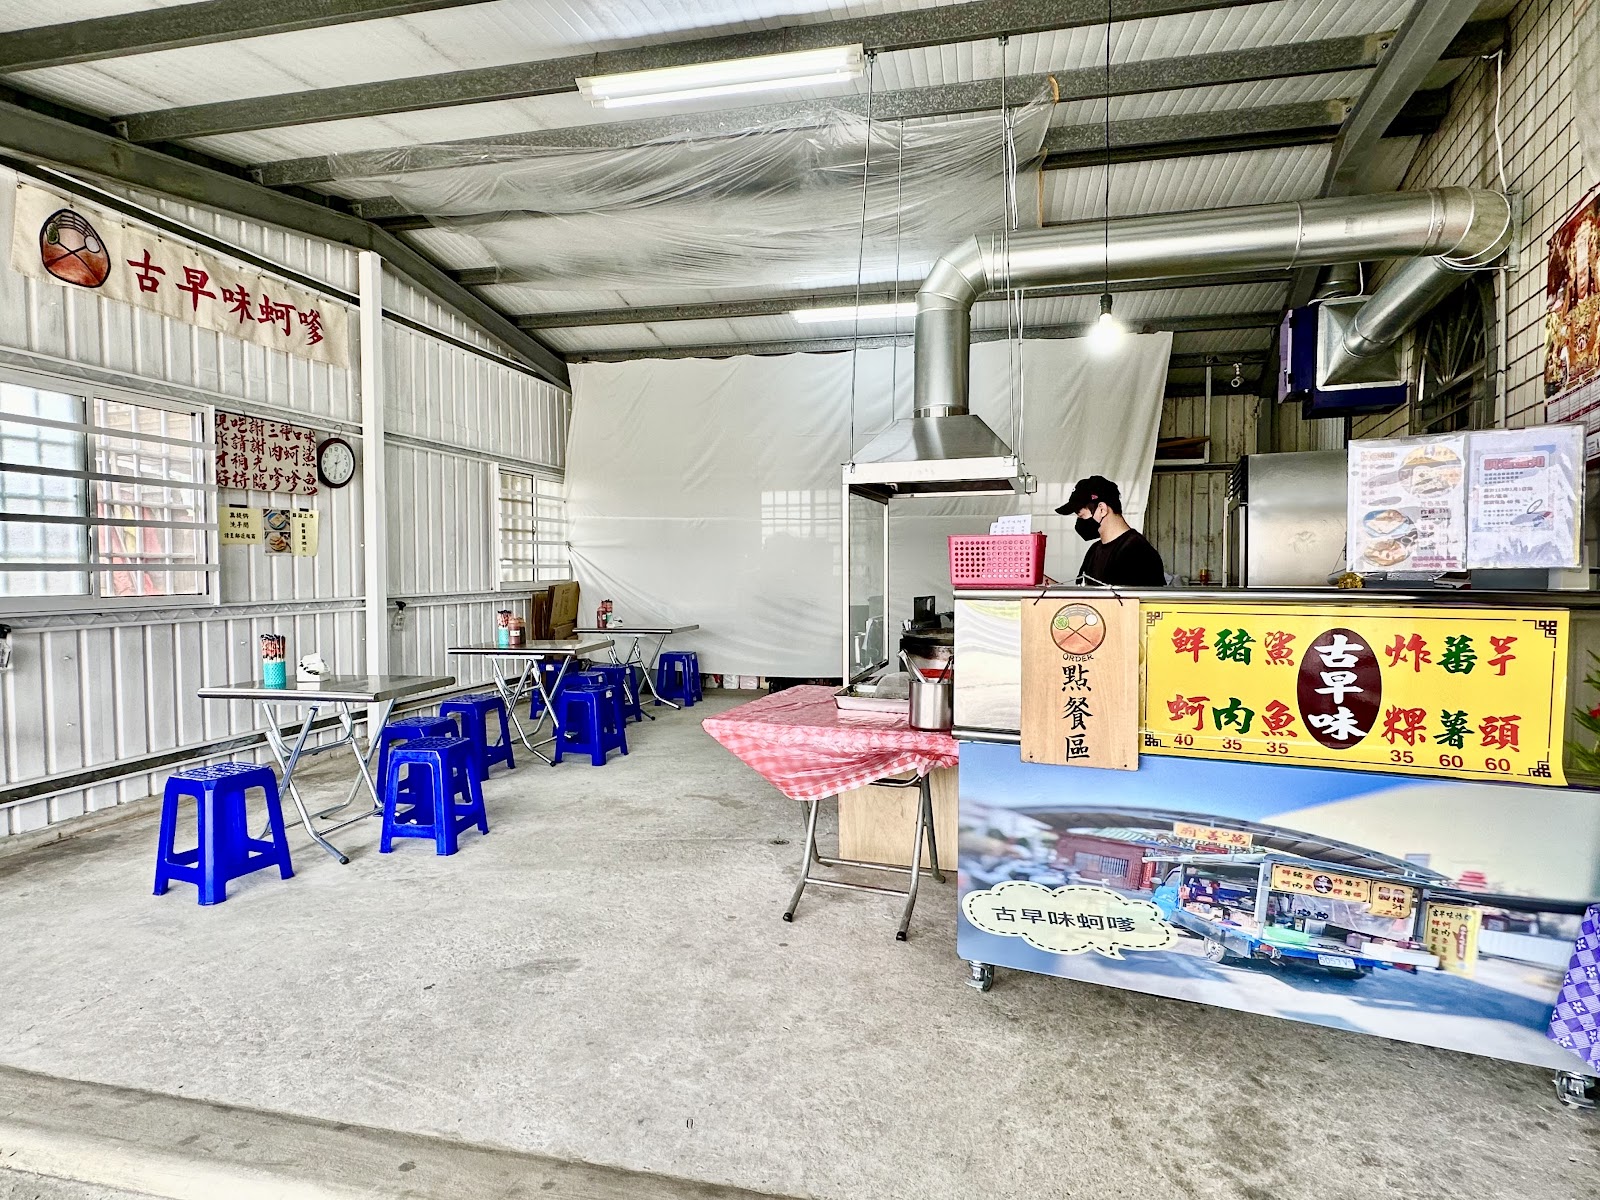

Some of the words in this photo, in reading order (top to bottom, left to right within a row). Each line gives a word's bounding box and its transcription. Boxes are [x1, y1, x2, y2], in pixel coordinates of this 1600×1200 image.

[127, 249, 324, 345] 古早味蚵嗲
[249, 418, 267, 490] 謝謝光臨
[1063, 653, 1094, 662] ORDER
[1308, 634, 1369, 740] 古早味
[1061, 664, 1093, 762] 點餐區
[1174, 734, 1194, 746] 40
[1222, 737, 1242, 750] 35
[1266, 742, 1289, 754] 35
[1390, 750, 1414, 763] 35
[1439, 754, 1464, 768] 60
[1485, 758, 1511, 771] 60
[991, 906, 1136, 932] 古早味蚵嗲
